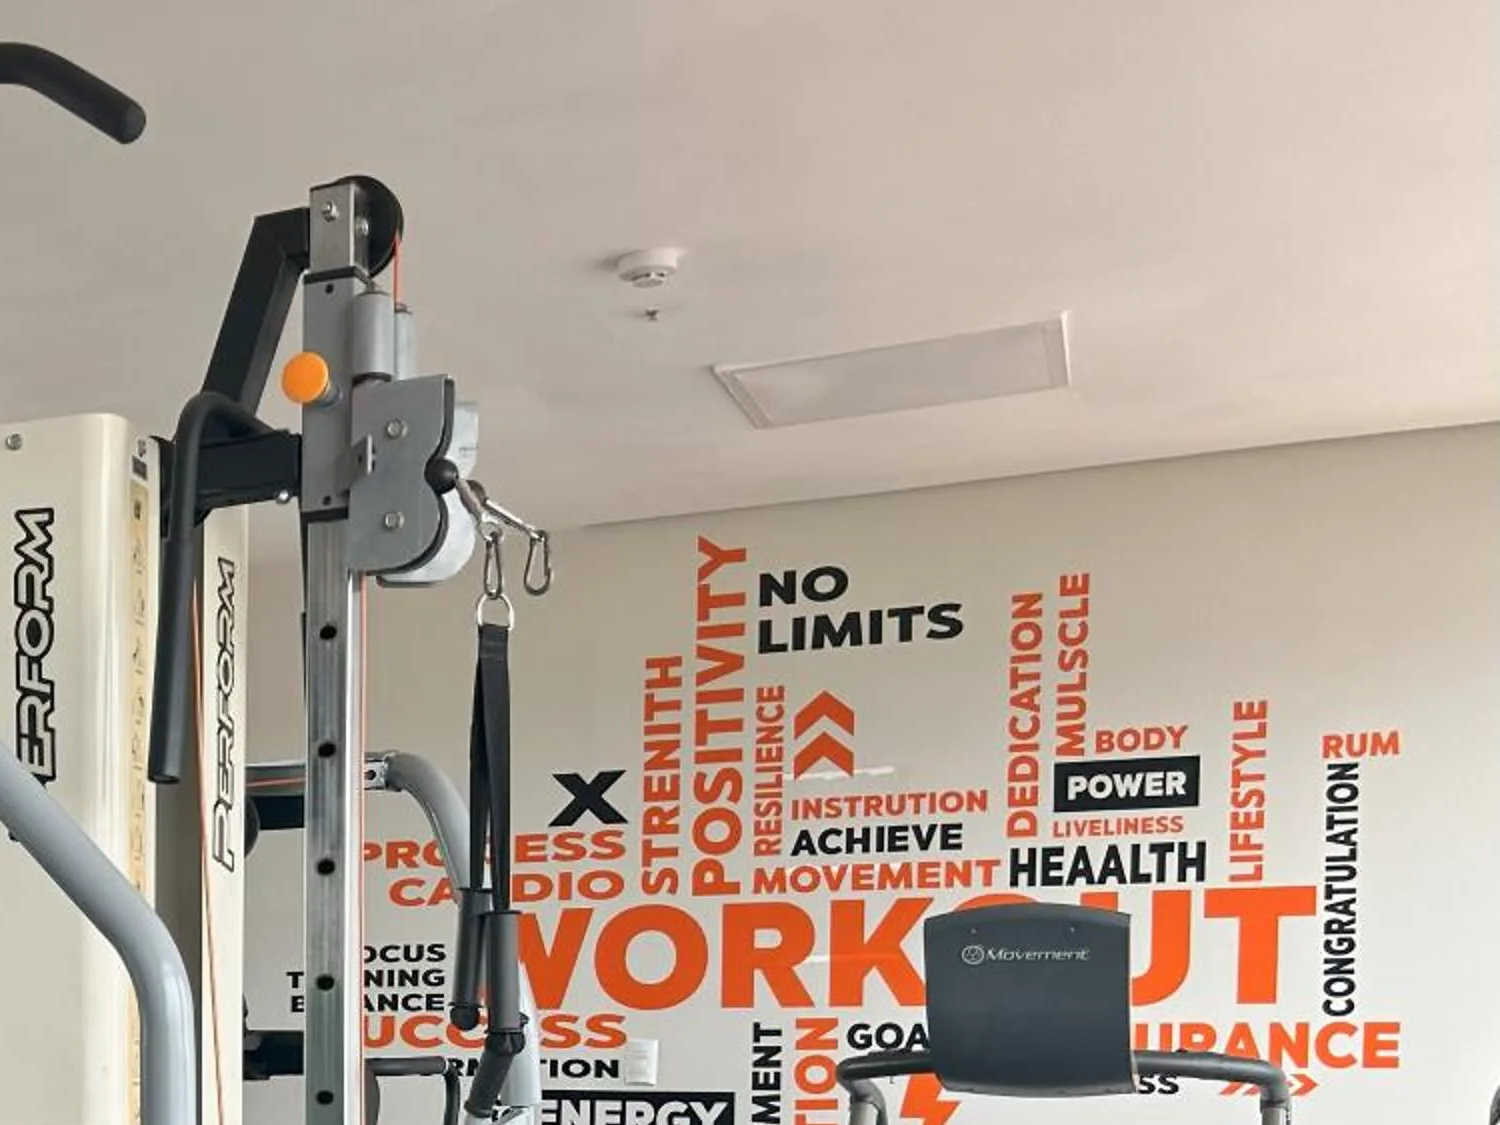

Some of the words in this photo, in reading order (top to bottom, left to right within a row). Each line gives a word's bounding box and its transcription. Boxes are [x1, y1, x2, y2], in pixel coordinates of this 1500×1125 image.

[759, 565, 849, 608] NO
[13, 506, 57, 786] ERFORM
[758, 602, 964, 654] LIMITS
[1055, 572, 1092, 757] MULSCLE
[211, 555, 236, 873] PERFORM
[691, 536, 748, 897] POSITIVITY
[1006, 591, 1045, 839] DEDICATION
[1094, 725, 1189, 754] BODY
[1321, 730, 1402, 760] RUM
[640, 654, 684, 896] STRENITH
[752, 685, 785, 857] RESILIENCE
[1066, 770, 1188, 801] POWER
[1229, 700, 1269, 883] LIFESTYLE
[548, 769, 629, 828] X
[790, 789, 989, 820] INSTRUTION
[790, 823, 963, 857] ACHIEVE
[1052, 815, 1184, 838] LIVELINESS
[751, 858, 1001, 894] MOVEMENT
[1009, 841, 1207, 887] HEAALTH
[389, 870, 625, 907] CADIO
[1322, 761, 1360, 1017] CONGRATULATION
[364, 943, 447, 963] OCUS
[516, 885, 1318, 1010] WORKUT
[985, 947, 1091, 962] Movement
[286, 968, 445, 988] TNING
[364, 1013, 627, 1050] UCCSS
[846, 1021, 928, 1051] GOA
[1134, 1021, 1401, 1069] URANCE
